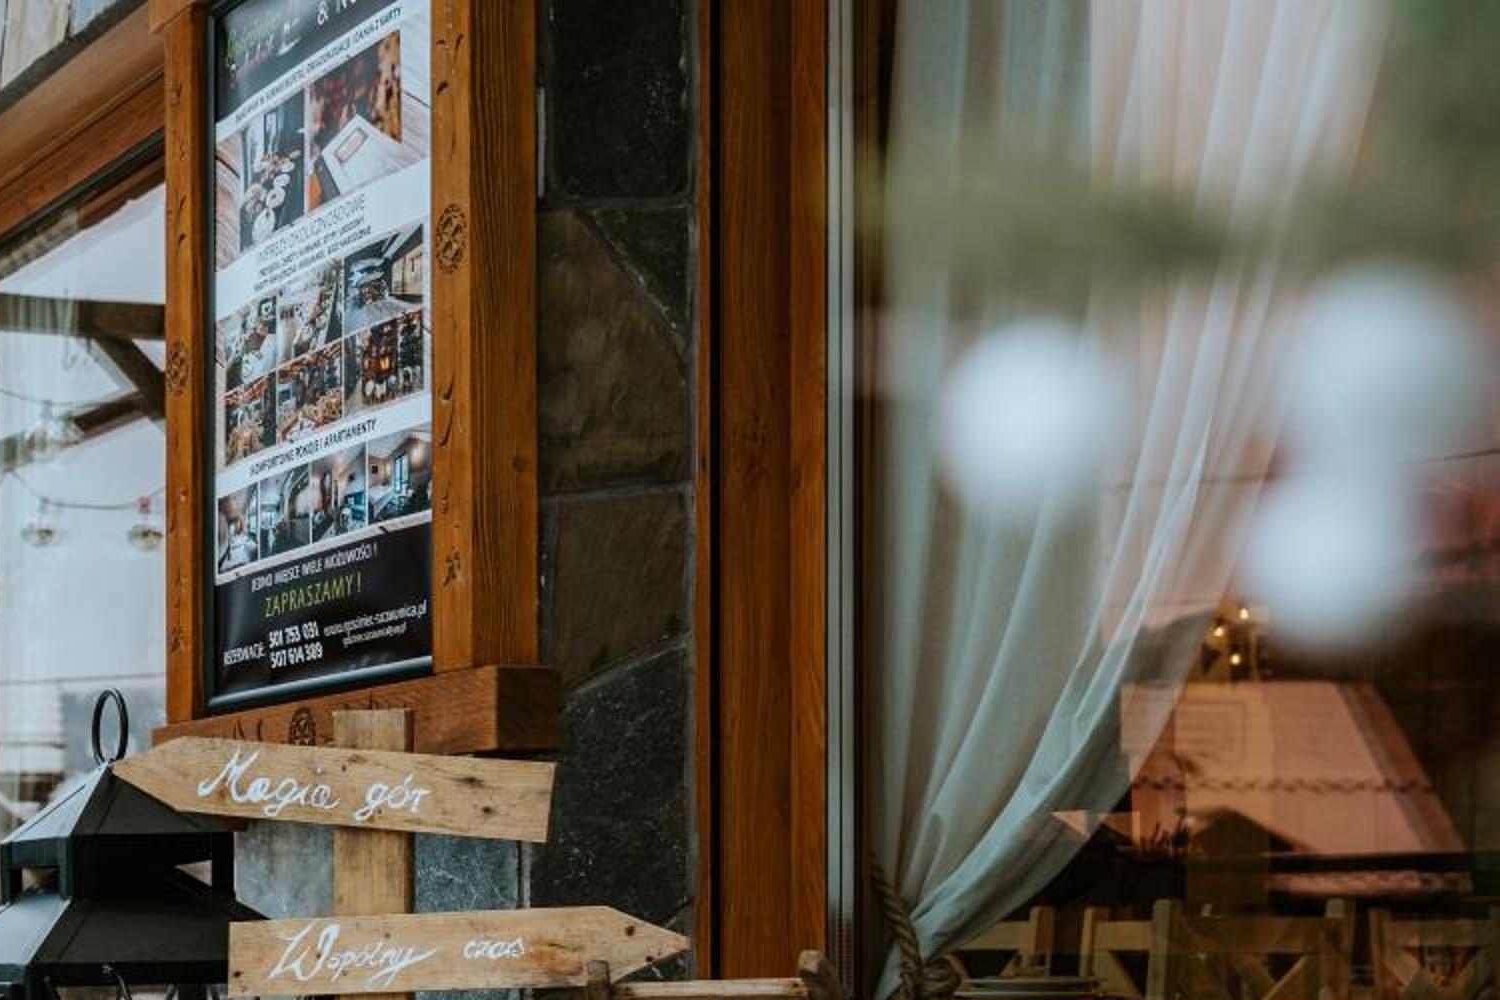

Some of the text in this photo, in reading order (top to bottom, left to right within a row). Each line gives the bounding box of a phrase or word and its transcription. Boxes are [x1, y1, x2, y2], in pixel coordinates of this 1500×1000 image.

[323, 418, 377, 449] APARTAMENTY
[264, 573, 354, 618] ZAPRASZAMY
[196, 746, 431, 821] Magia gór
[267, 920, 526, 990] Wspólny czas
